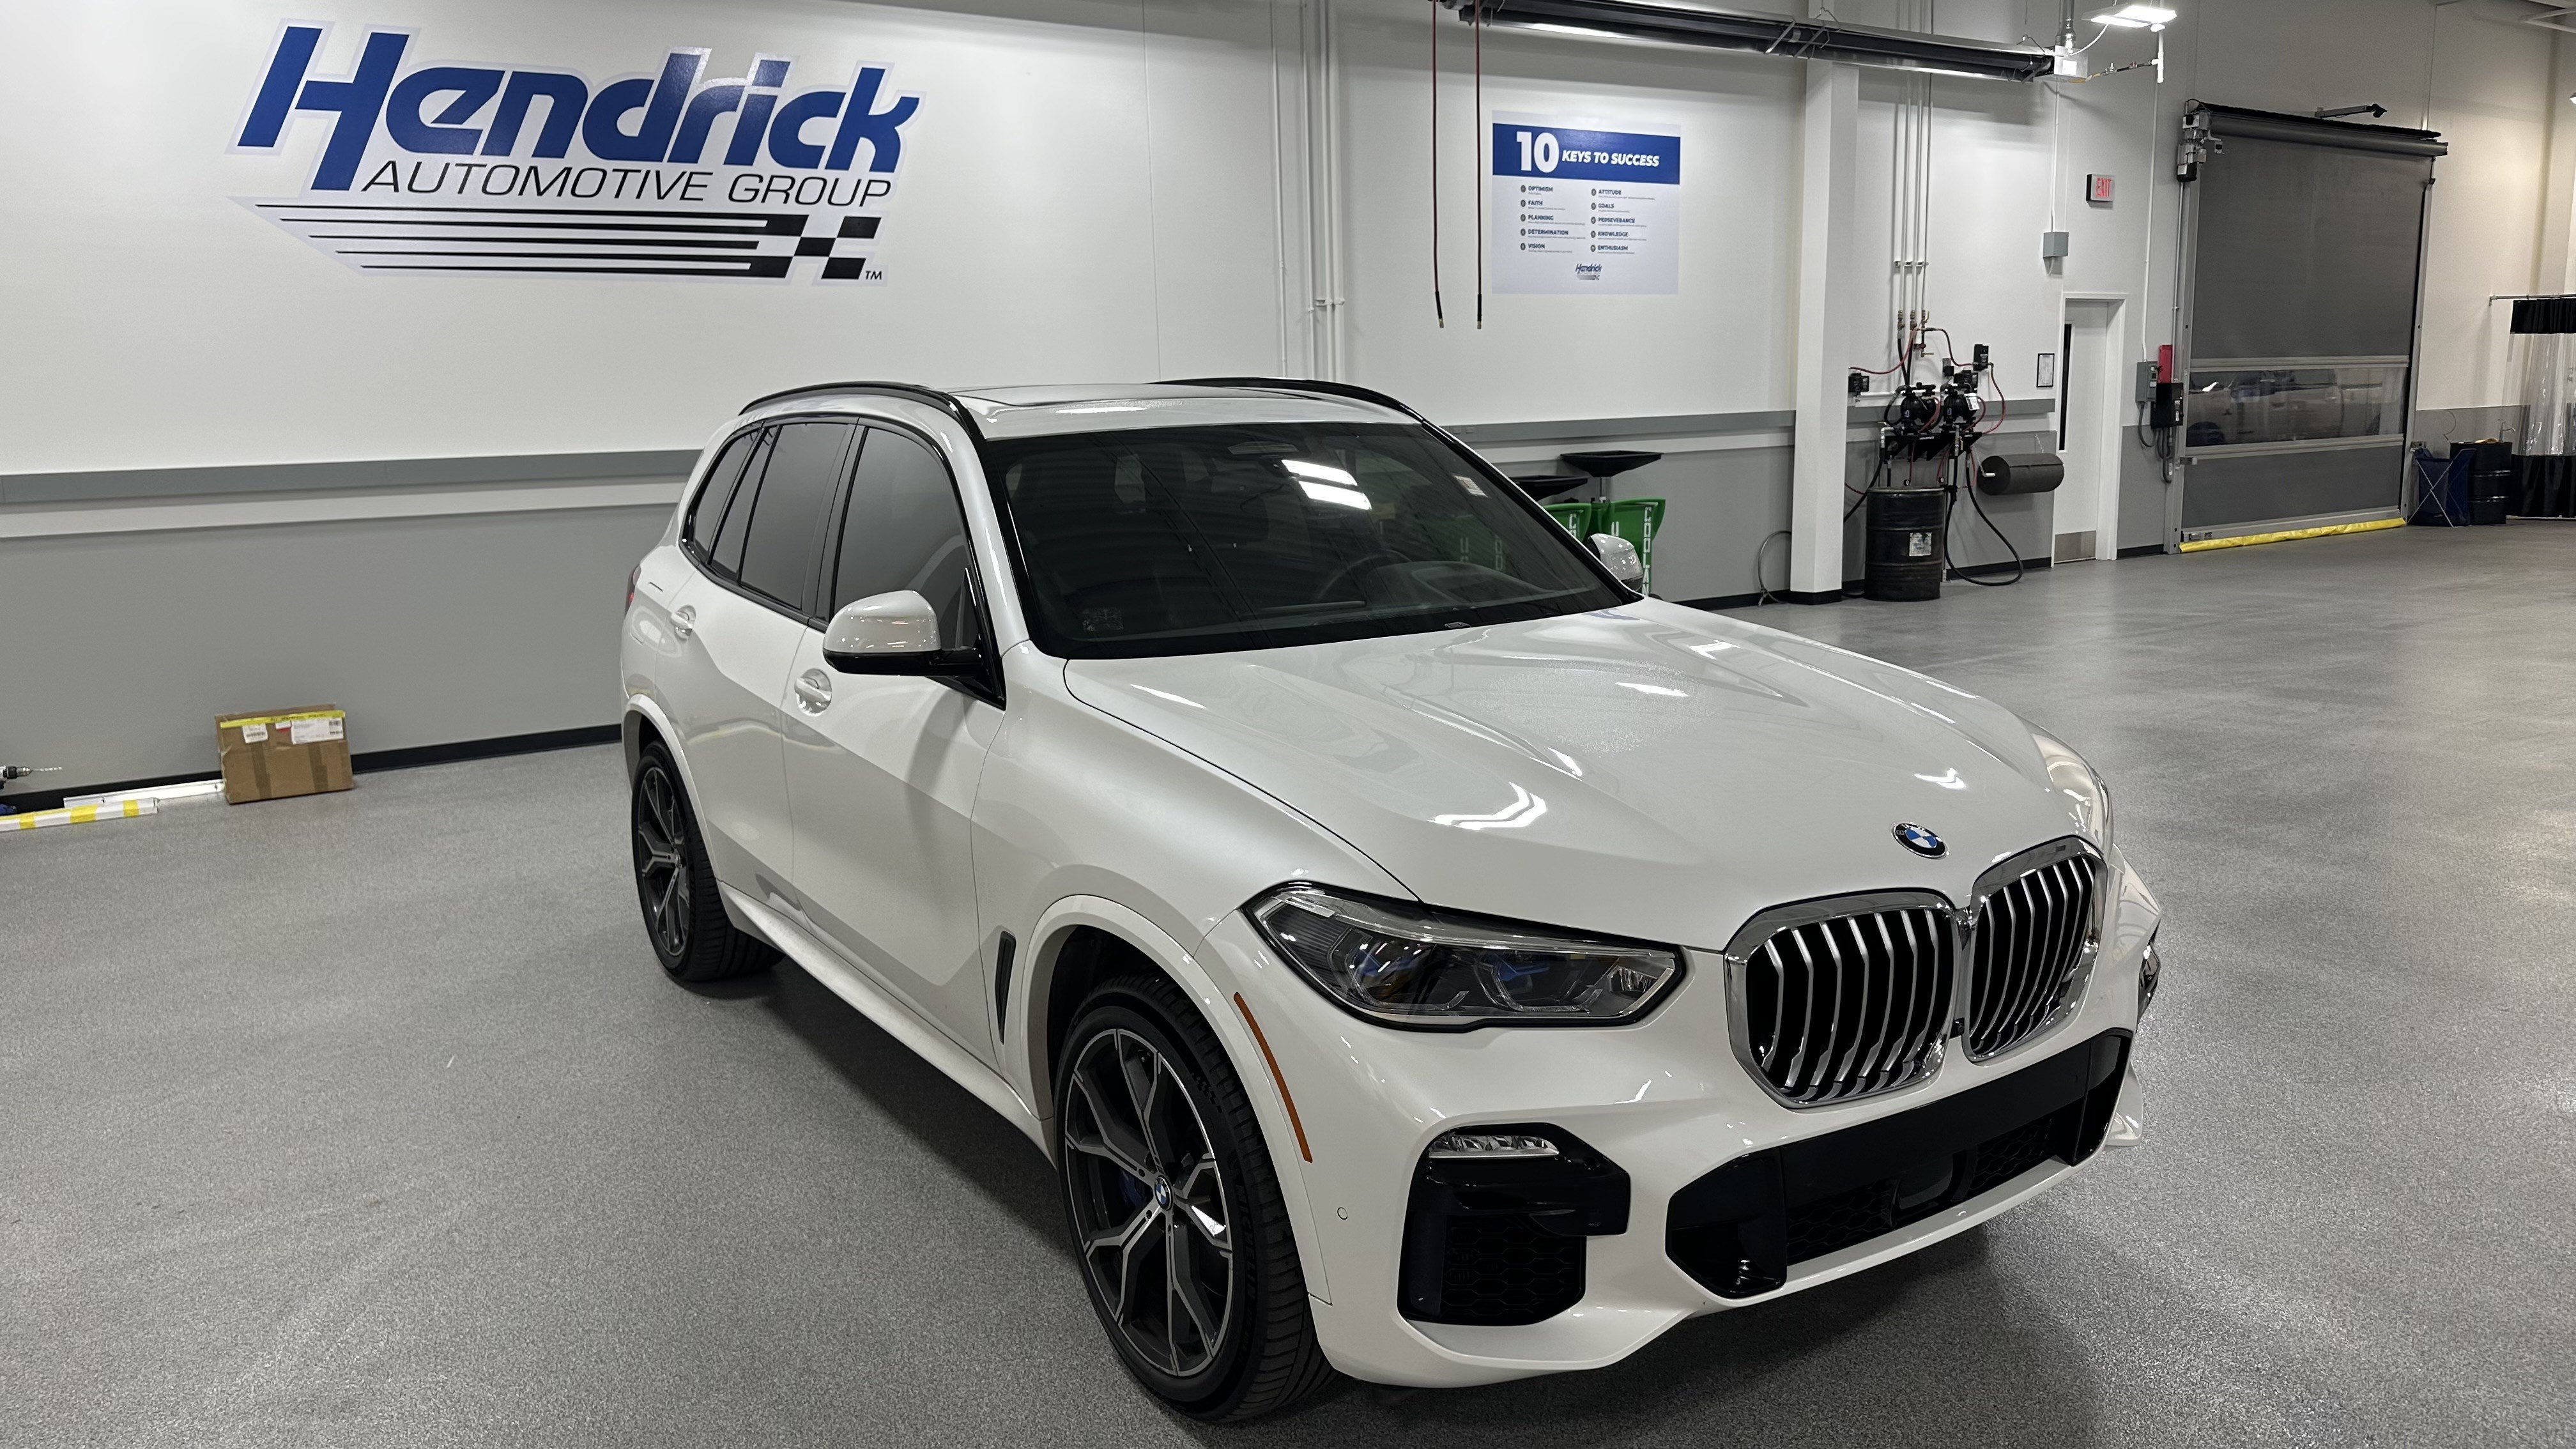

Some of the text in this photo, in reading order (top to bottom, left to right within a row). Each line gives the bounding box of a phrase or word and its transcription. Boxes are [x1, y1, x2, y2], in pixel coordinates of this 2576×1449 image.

[237, 26, 920, 192] Hendrick
[1516, 131, 1660, 173] 10 KEYS TO SUCCESS
[361, 160, 892, 208] AUTOMOTIVE GROUP
[2096, 178, 2112, 197] EXIT
[865, 270, 882, 280] TM
